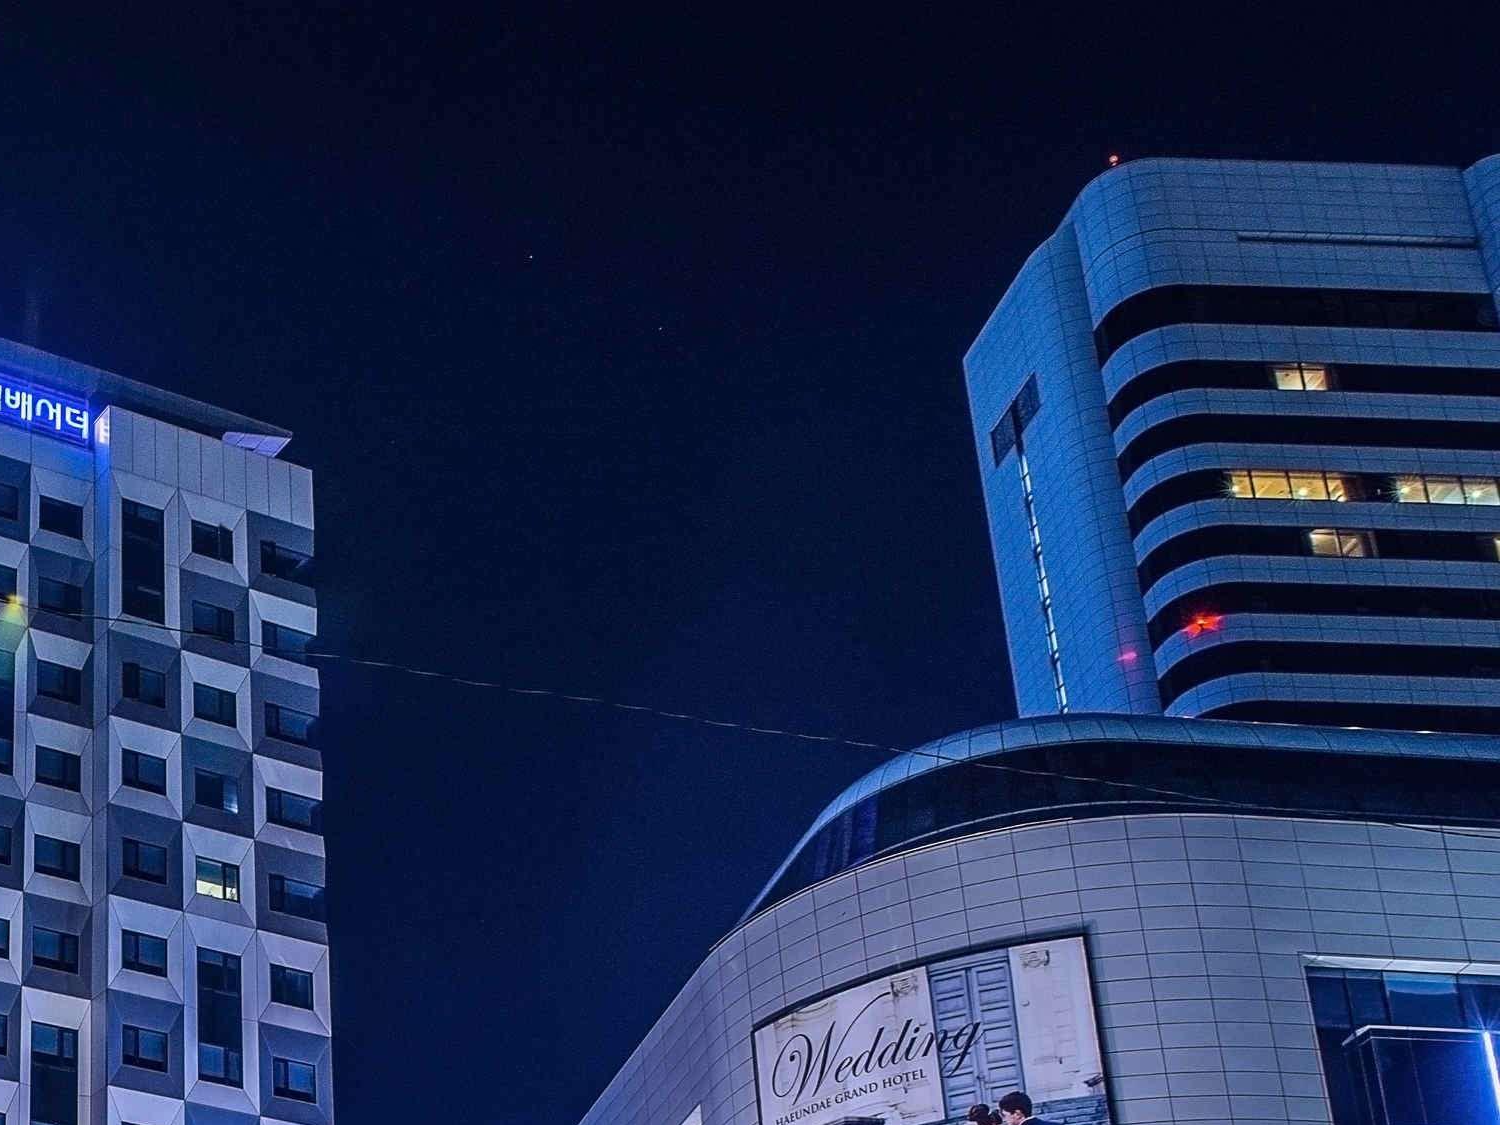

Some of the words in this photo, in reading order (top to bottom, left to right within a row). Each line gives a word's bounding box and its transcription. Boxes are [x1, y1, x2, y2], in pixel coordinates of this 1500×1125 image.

[772, 991, 983, 1106] Wedding
[834, 1082, 879, 1105] GRAND
[882, 1068, 928, 1091] HOTEL
